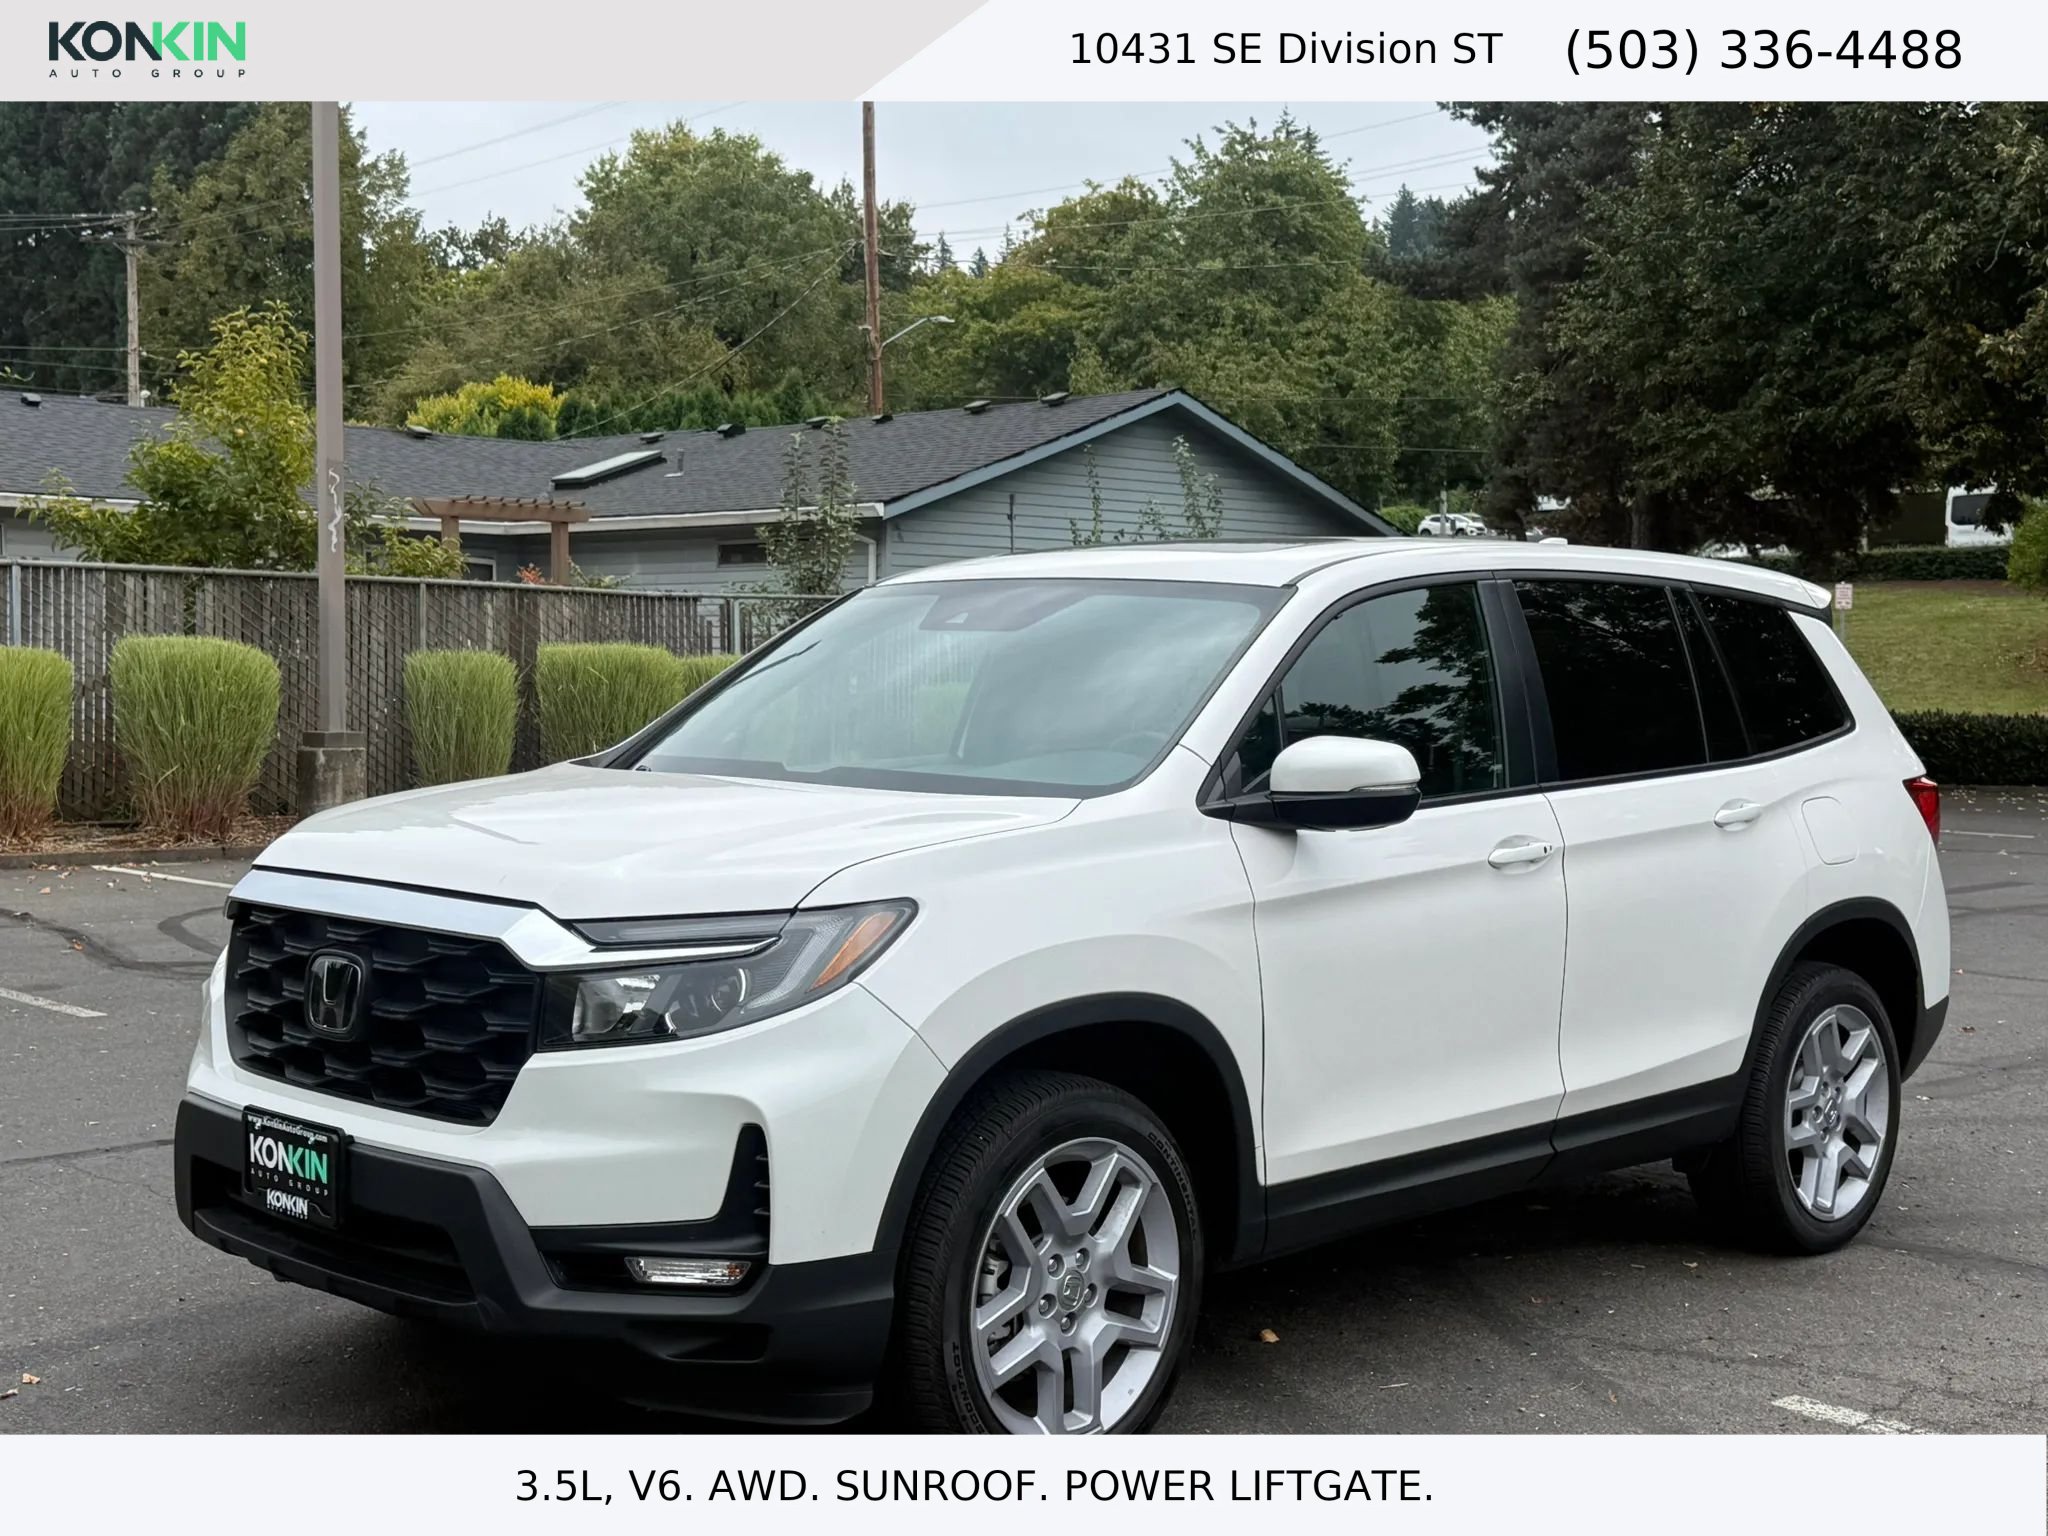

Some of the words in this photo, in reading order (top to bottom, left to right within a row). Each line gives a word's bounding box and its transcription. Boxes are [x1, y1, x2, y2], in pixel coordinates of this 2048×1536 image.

[249, 1133, 328, 1184] KONKIN
[251, 1168, 279, 1182] AUTO
[266, 1188, 308, 1216] KONKIN
